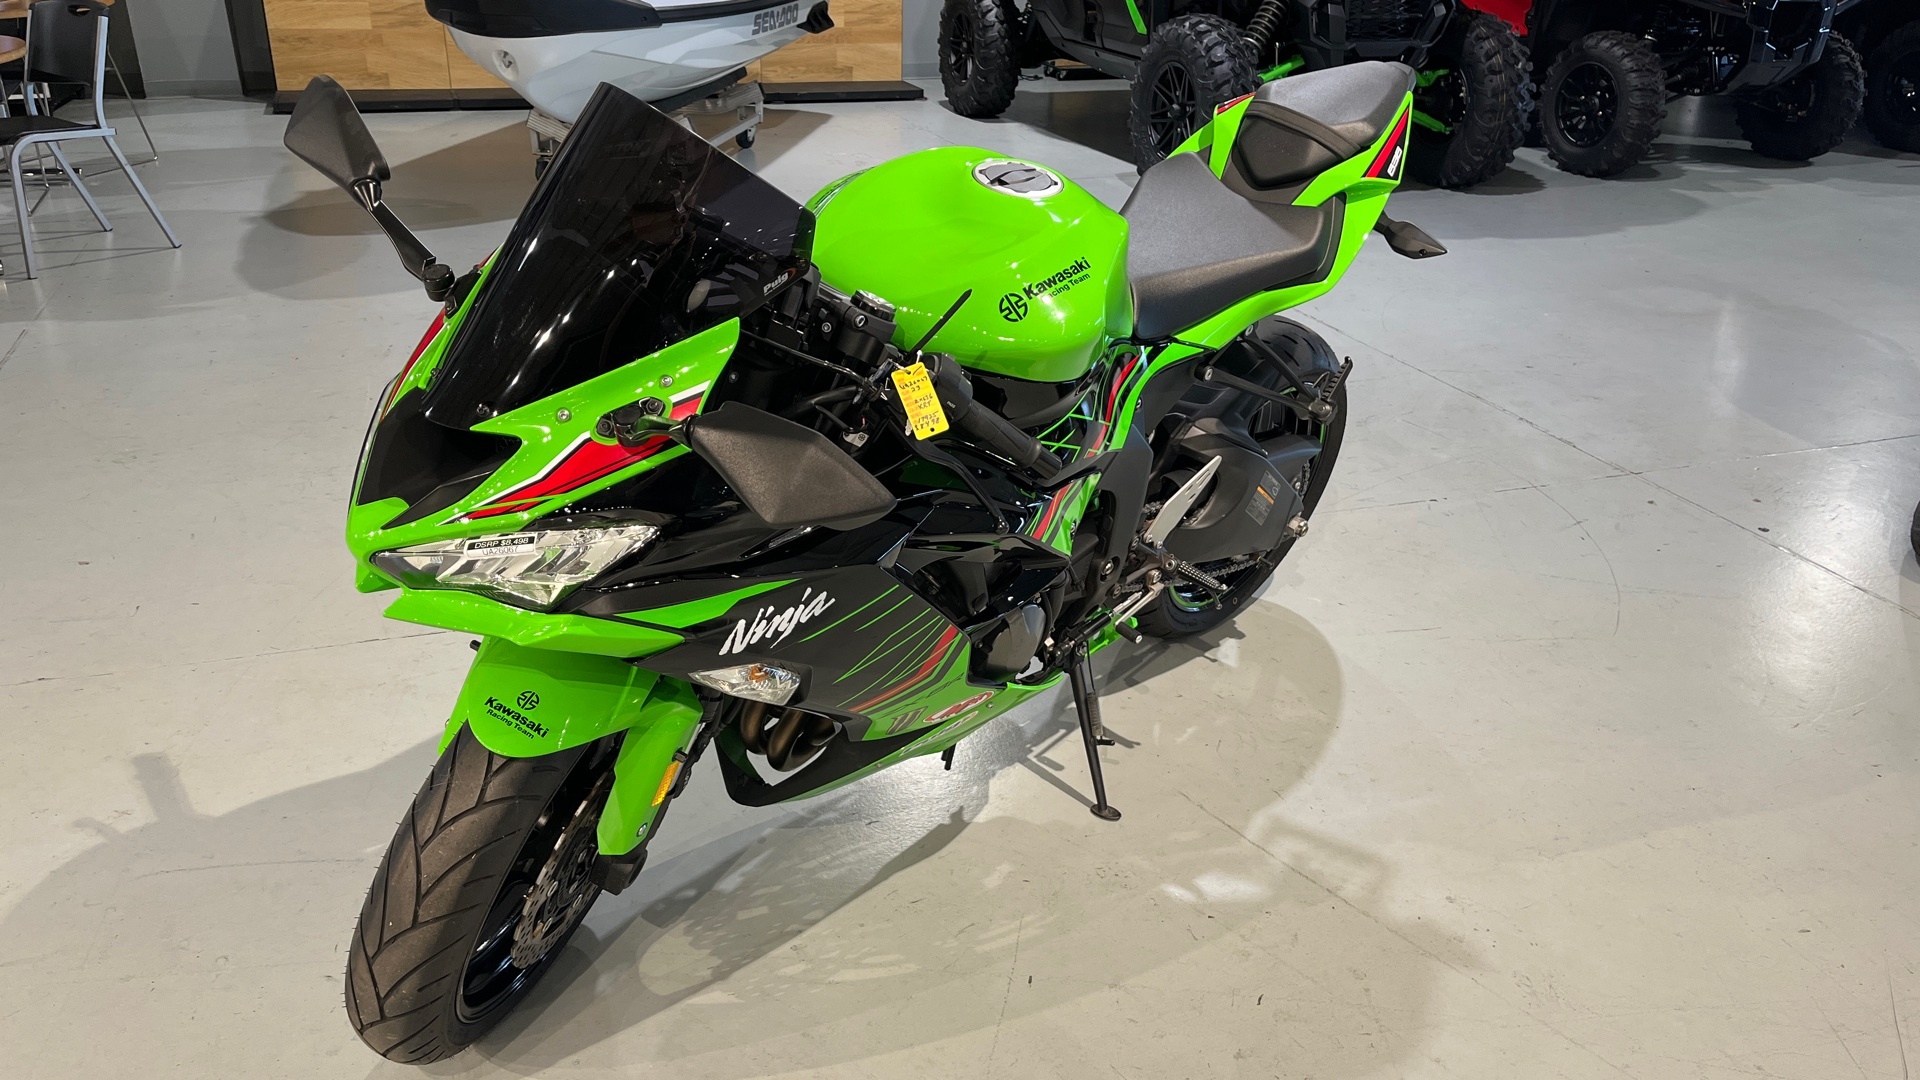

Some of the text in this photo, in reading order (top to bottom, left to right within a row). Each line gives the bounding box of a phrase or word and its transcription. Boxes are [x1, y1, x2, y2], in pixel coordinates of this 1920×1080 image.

[1022, 256, 1091, 300] Kawasaki
[1068, 273, 1091, 287] Team
[474, 537, 529, 549] DSRP $8,498
[718, 586, 836, 656] Ninja
[484, 696, 550, 739] Kawasaki
[486, 708, 535, 739] Racing Team
